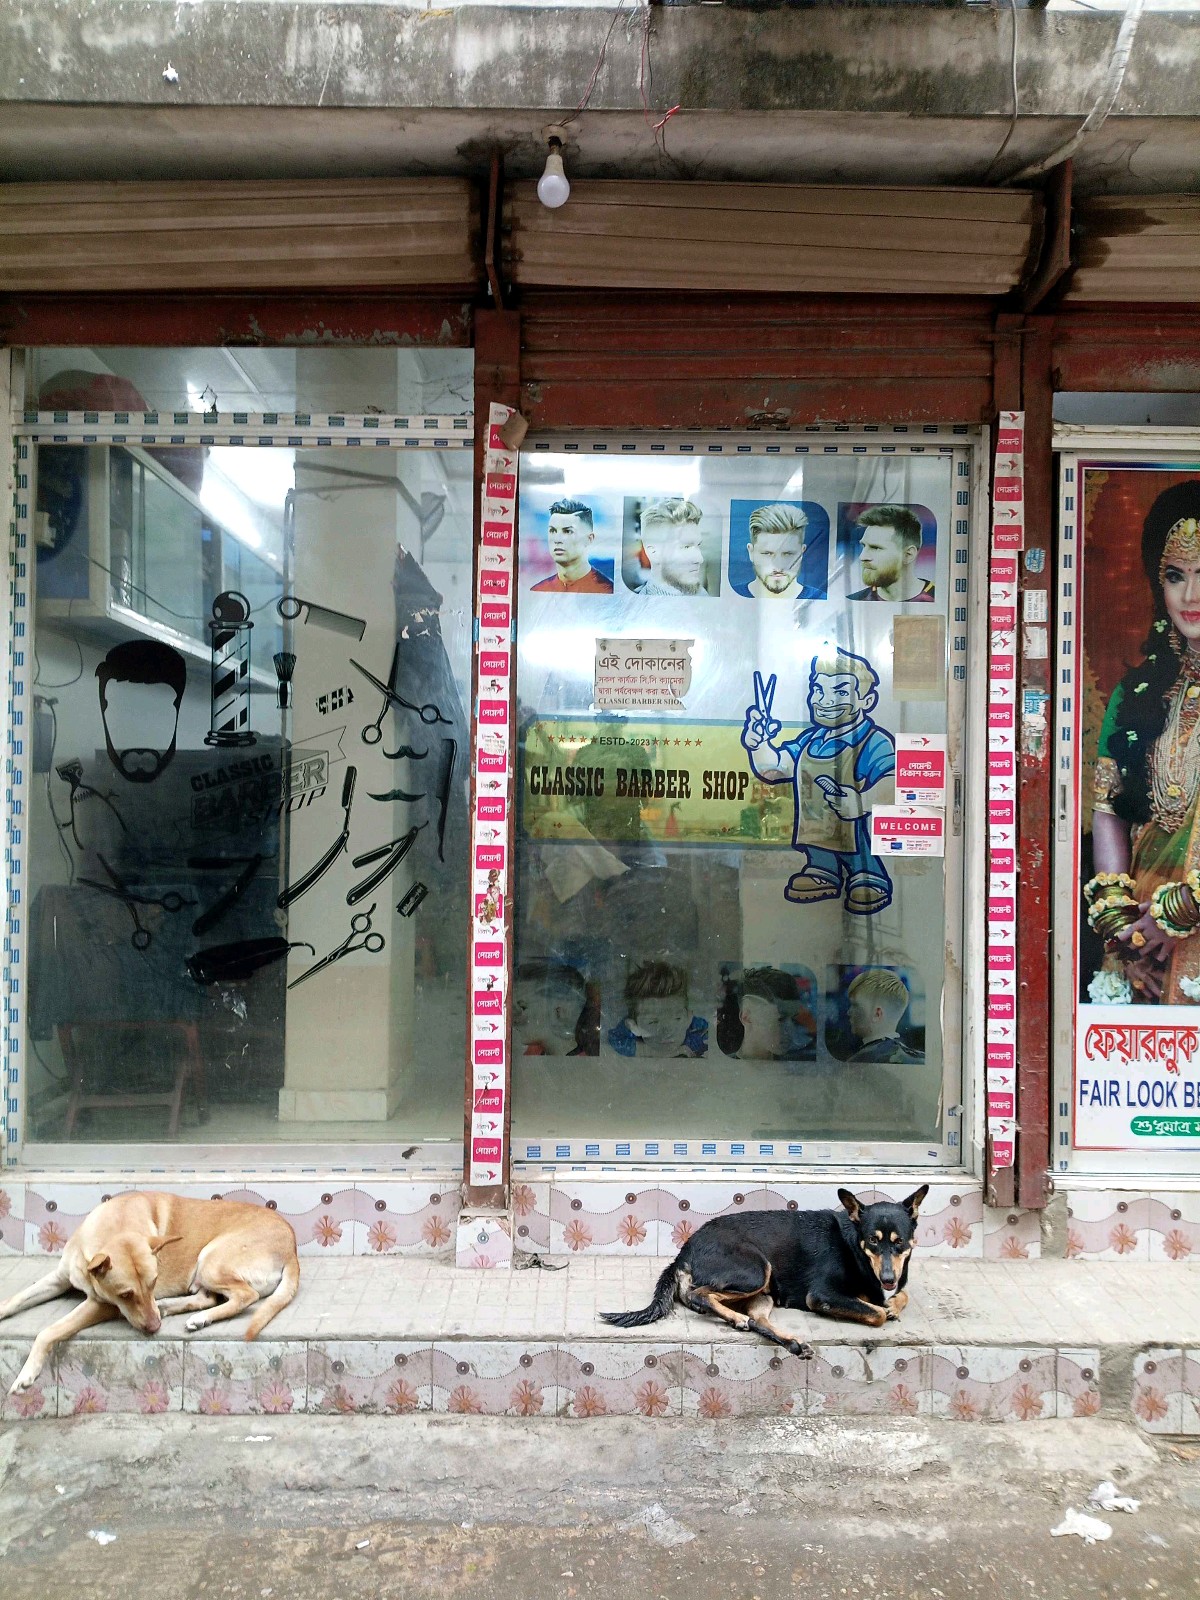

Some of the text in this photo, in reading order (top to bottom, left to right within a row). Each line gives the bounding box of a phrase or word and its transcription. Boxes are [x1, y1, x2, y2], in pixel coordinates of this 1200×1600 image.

[598, 653, 686, 671] এই দোকানের
[598, 697, 631, 705] CLASSIC
[190, 753, 275, 792] CLASSIC
[899, 768, 942, 778] বিকাশ করুন
[908, 761, 932, 770] পেমেন্ট
[530, 765, 749, 801] CLASSIC BARBER SHOP
[879, 821, 937, 831] WELCOME
[1084, 1024, 1199, 1074] ফেয়ারলুক
[1079, 1079, 1121, 1107] FAIR
[1126, 1080, 1178, 1108] LOOK
[1134, 1120, 1192, 1136] শুধুমাত্র
